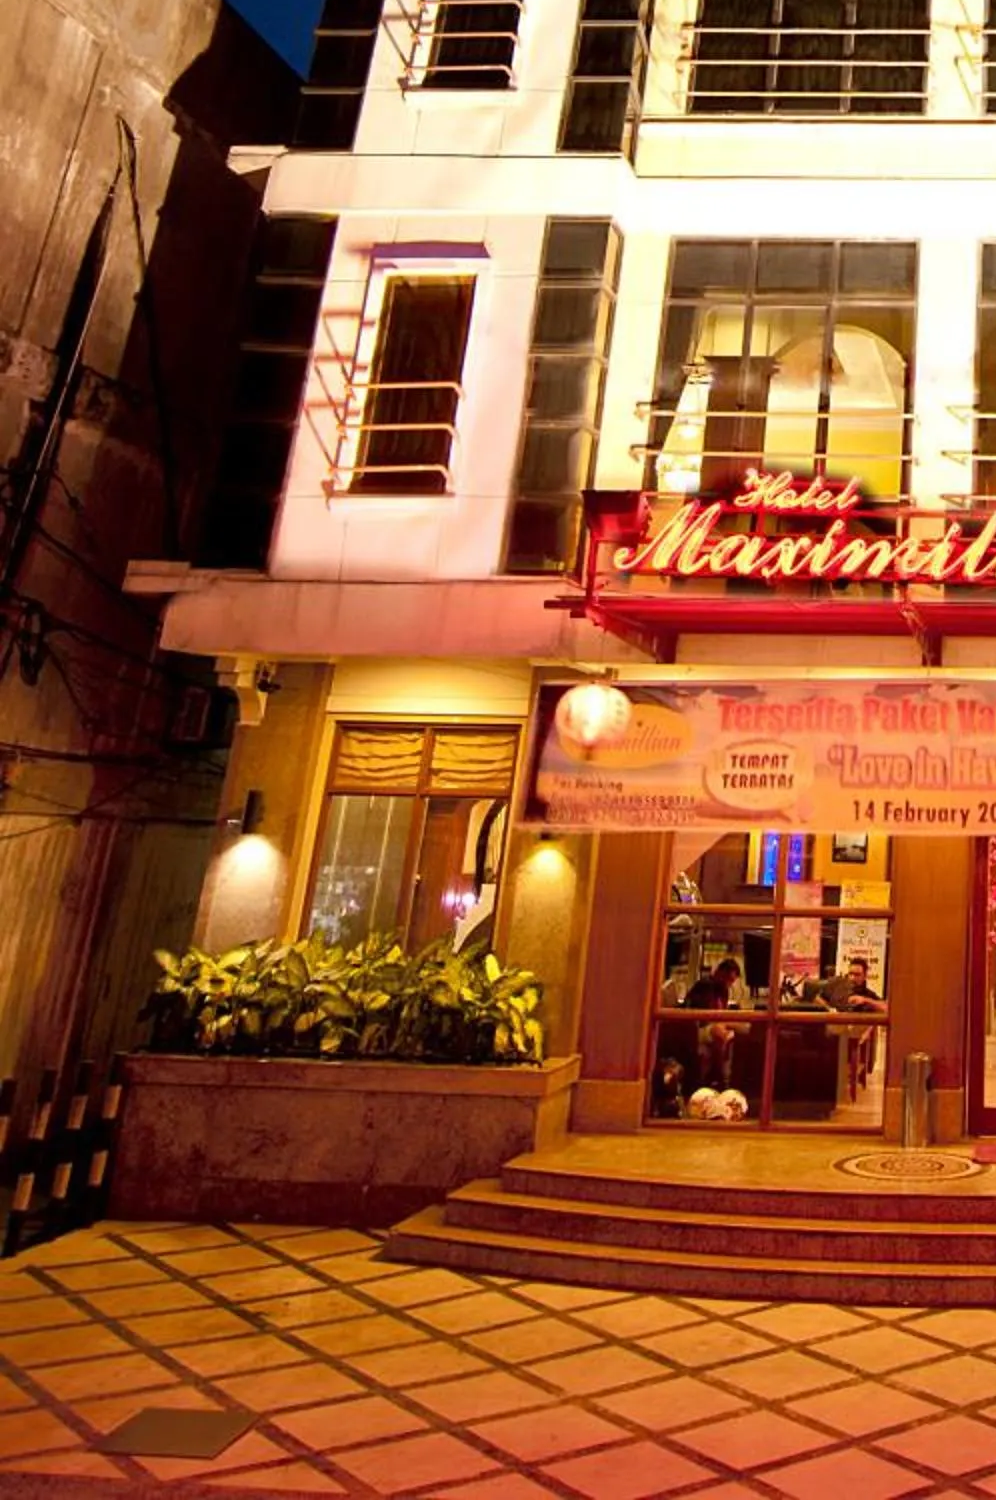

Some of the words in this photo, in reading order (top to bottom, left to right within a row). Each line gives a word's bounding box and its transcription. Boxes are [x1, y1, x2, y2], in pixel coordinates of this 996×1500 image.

[735, 467, 860, 512] Hotel
[862, 697, 949, 734] Paket
[731, 755, 790, 770] TEMPAT
[853, 799, 875, 822] 14
[883, 799, 970, 829] February
